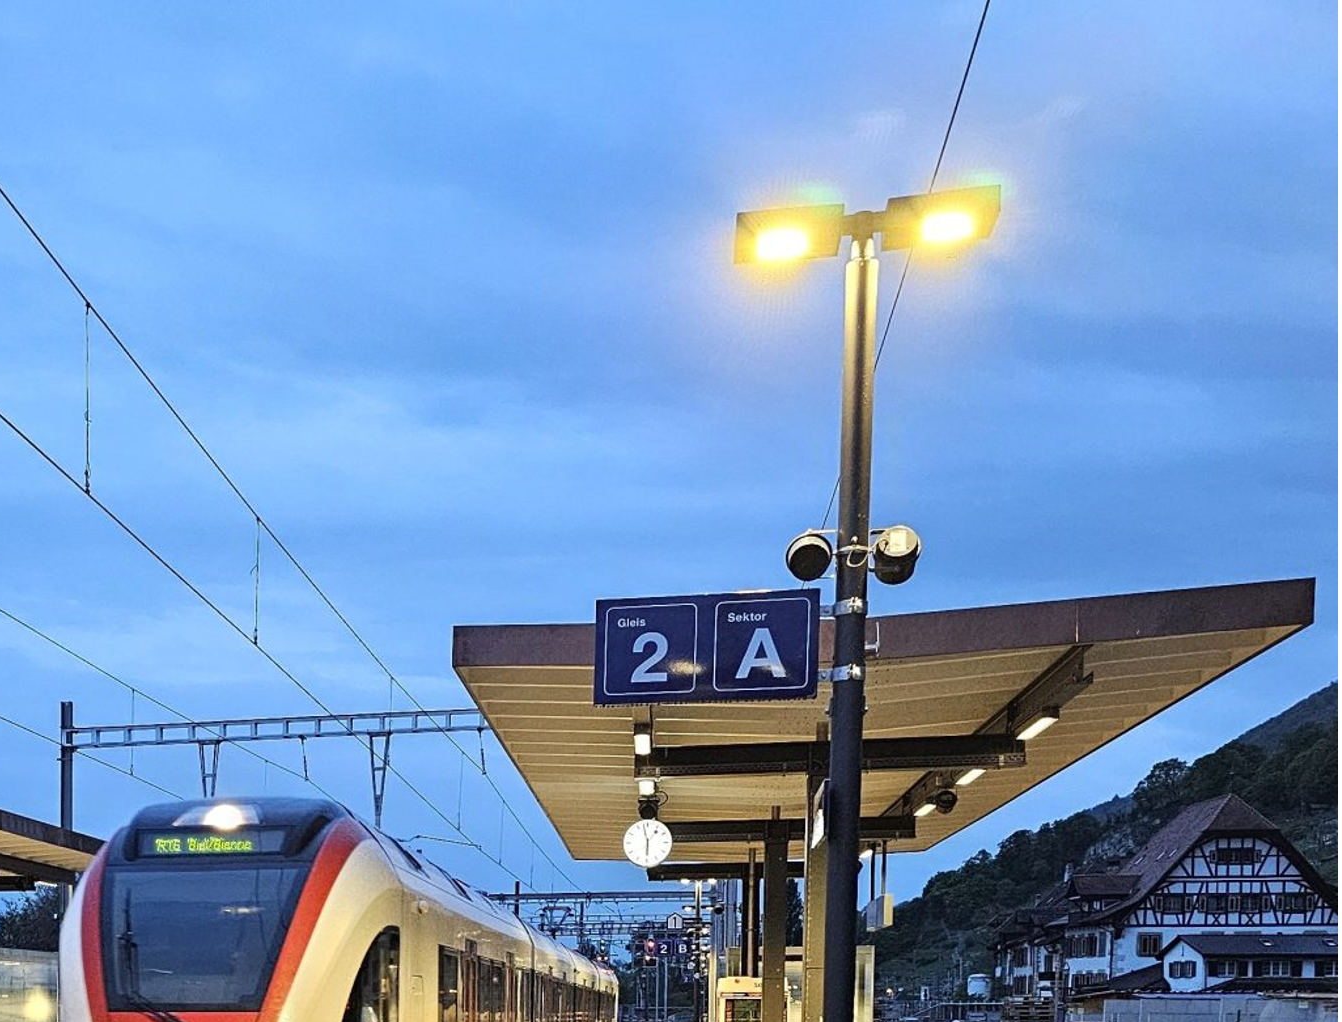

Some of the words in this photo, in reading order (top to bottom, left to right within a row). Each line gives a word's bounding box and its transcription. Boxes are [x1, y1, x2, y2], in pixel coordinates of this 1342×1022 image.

[618, 617, 646, 628] Gleis
[728, 612, 767, 623] Sektor
[631, 632, 669, 683] 2
[735, 627, 787, 679] A
[660, 944, 668, 954] 2
[678, 944, 688, 954] B
